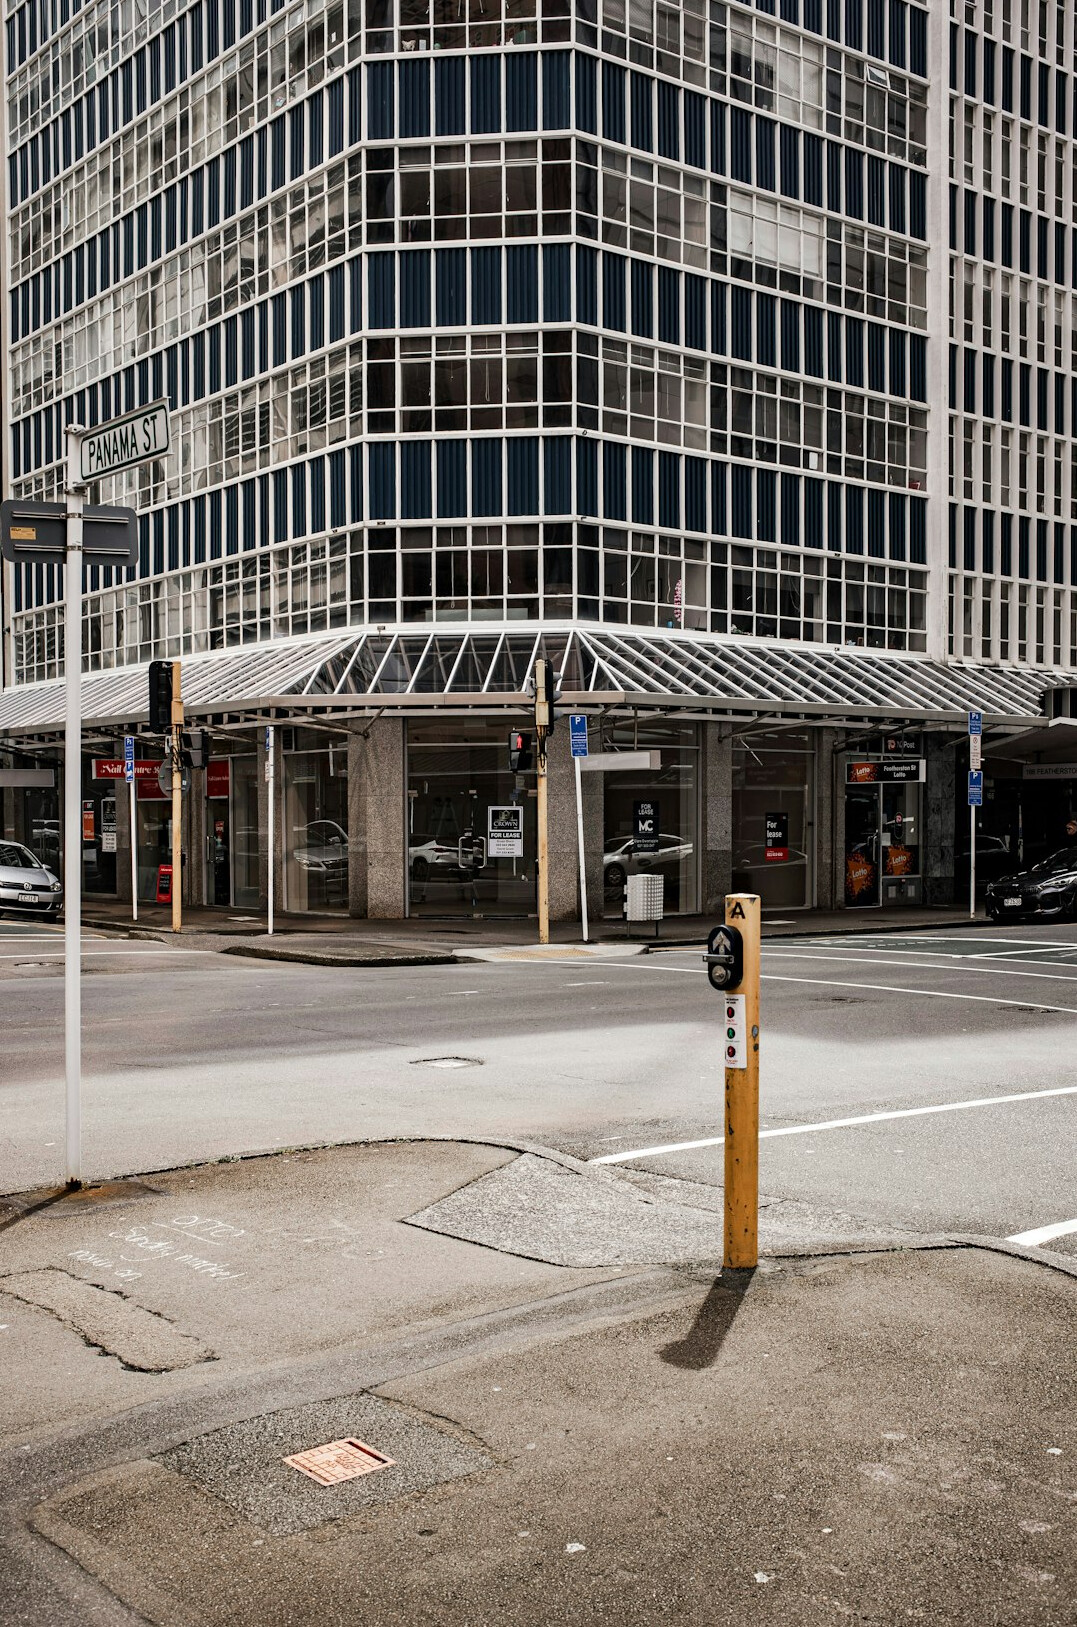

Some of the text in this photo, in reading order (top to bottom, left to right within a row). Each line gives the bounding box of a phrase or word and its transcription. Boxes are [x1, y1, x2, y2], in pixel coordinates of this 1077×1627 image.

[89, 414, 158, 473] PANAMA ST
[100, 763, 122, 774] Nail
[856, 767, 871, 775] Lotto
[1036, 767, 1077, 775] FEATHERSTO
[638, 819, 654, 832] MC
[766, 820, 778, 829] For
[766, 830, 783, 838] lease
[892, 855, 907, 865] Lotto
[852, 868, 868, 878] Lotto
[730, 901, 746, 920] A
